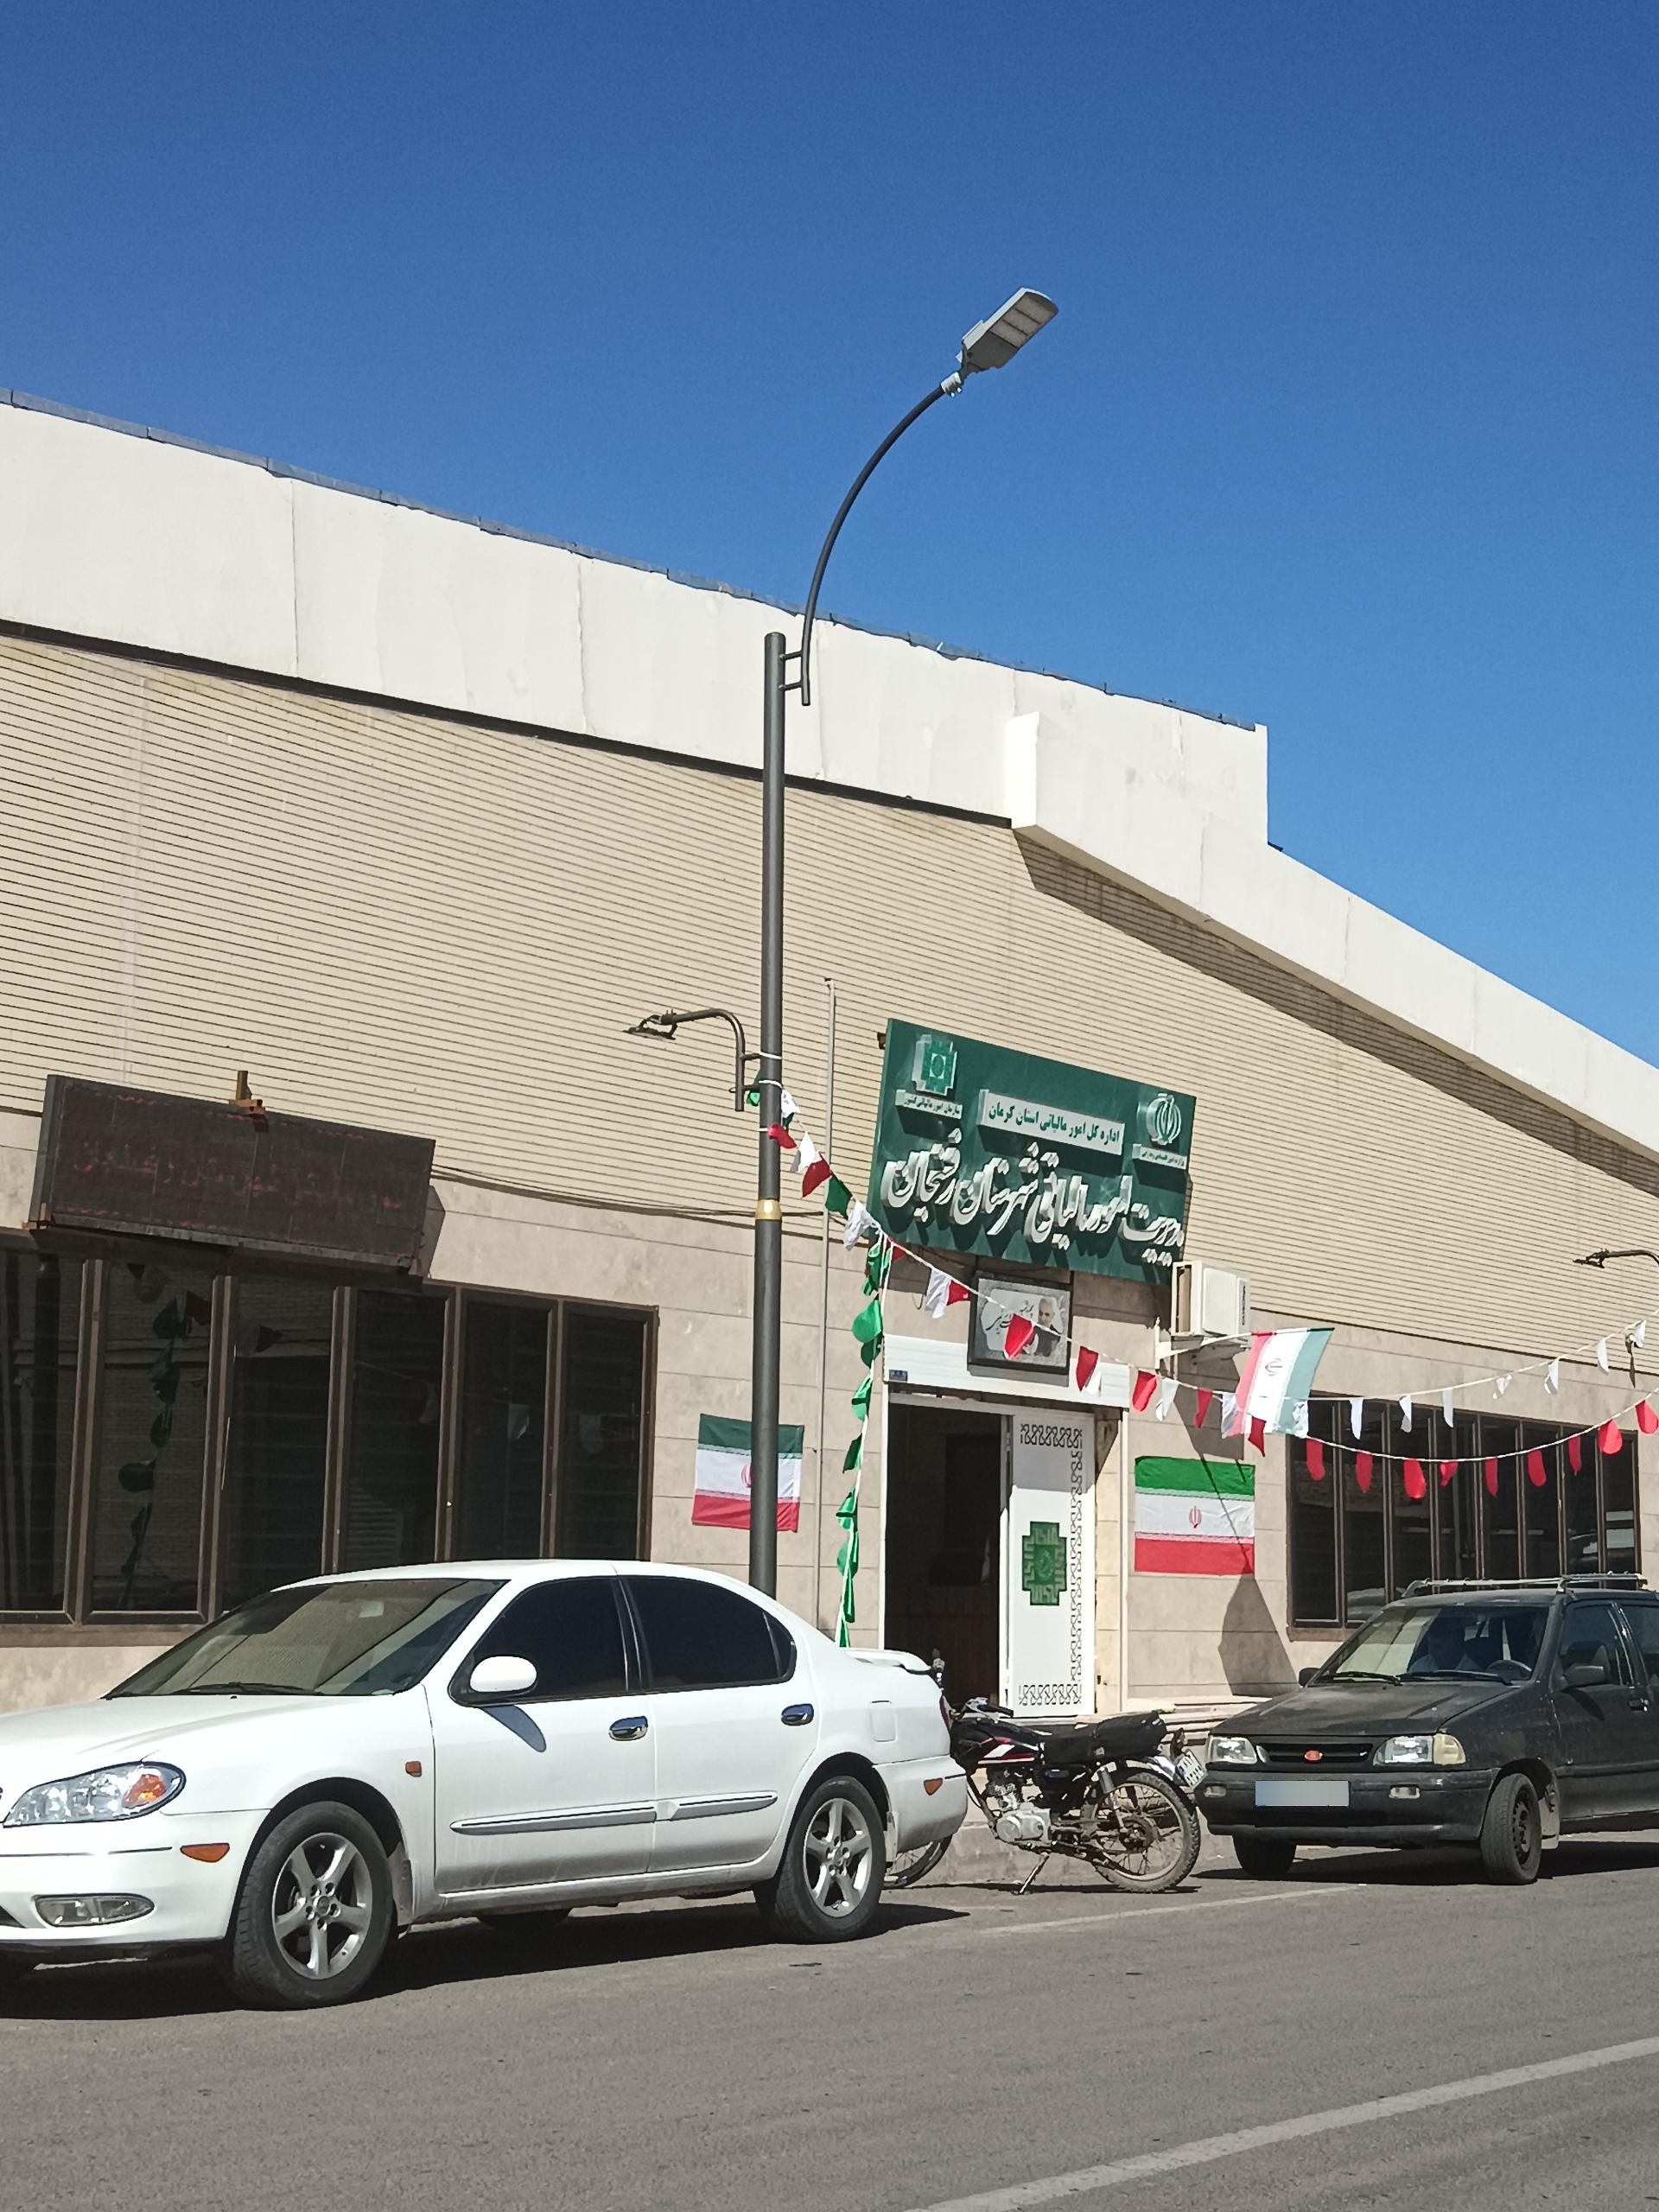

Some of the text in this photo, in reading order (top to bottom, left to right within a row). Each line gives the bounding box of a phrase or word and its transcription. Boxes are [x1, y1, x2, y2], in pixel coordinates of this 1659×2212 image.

[988, 1102, 1120, 1146] اداره کل امور مالیاتی استان کرمان
[880, 1128, 1185, 1268] مدیریت امور مالیاتی شهرستان رفسنجان
